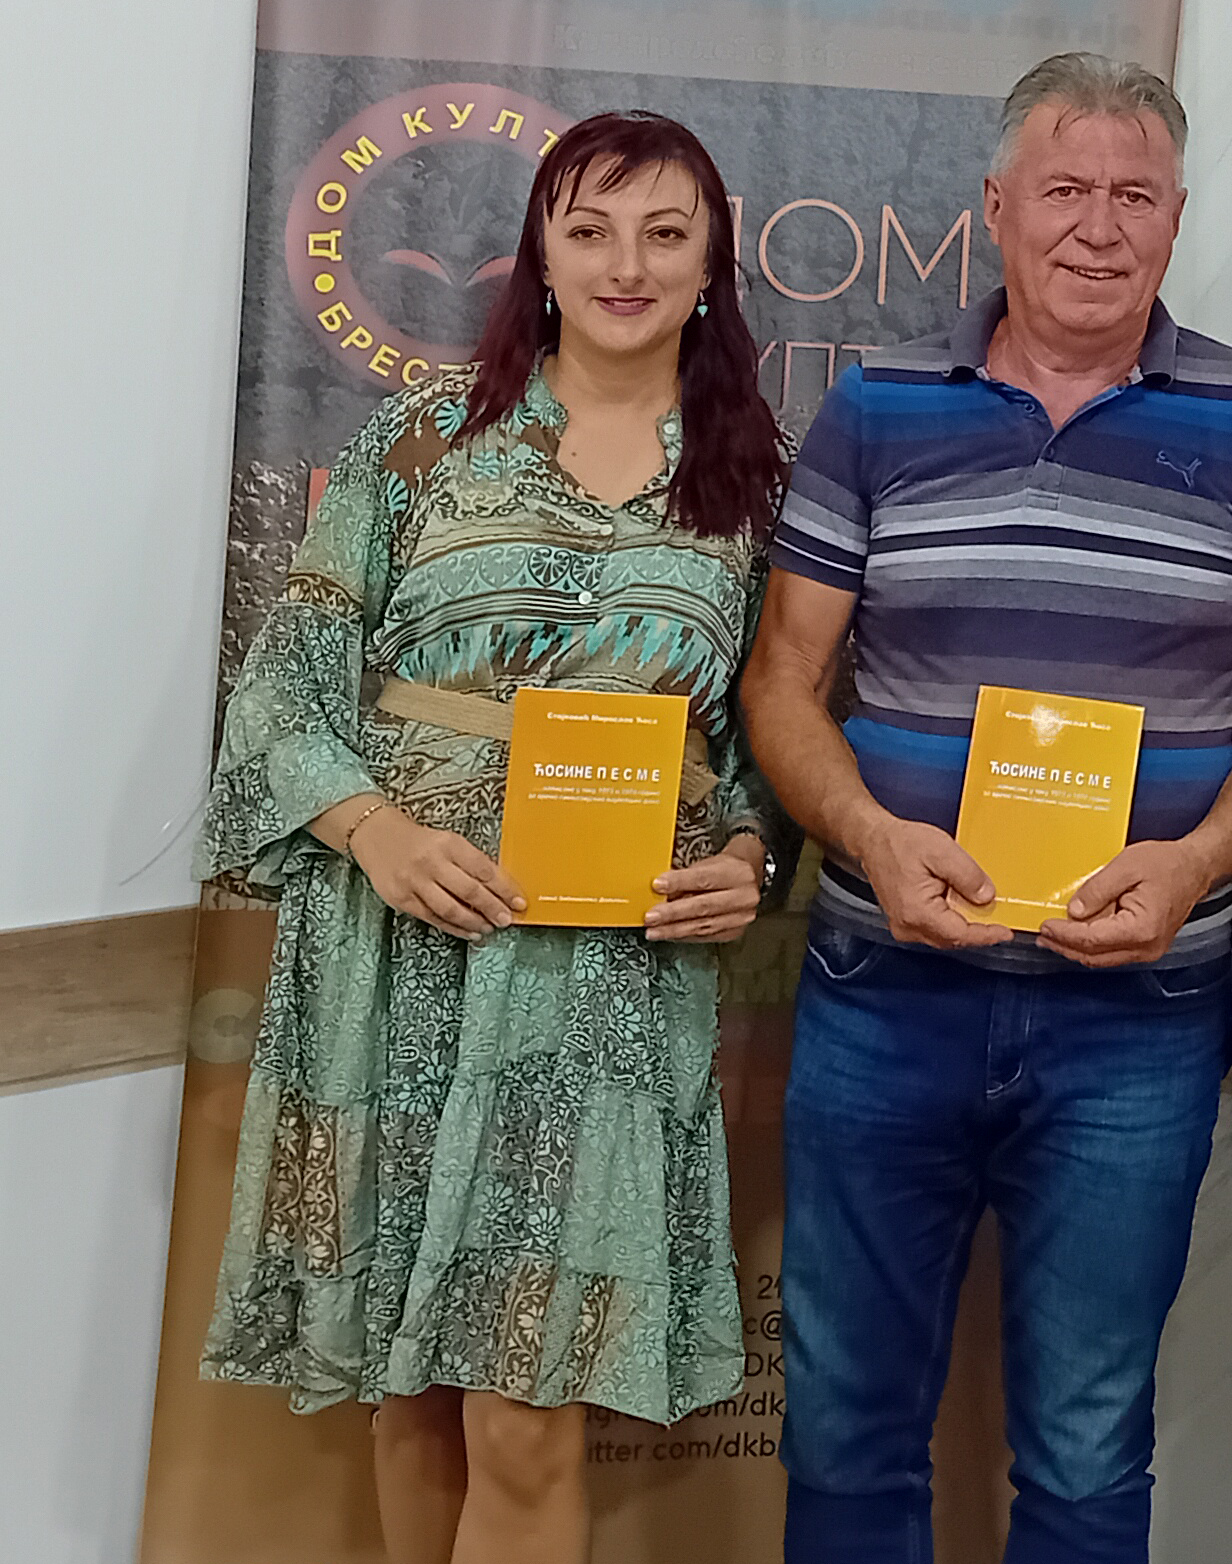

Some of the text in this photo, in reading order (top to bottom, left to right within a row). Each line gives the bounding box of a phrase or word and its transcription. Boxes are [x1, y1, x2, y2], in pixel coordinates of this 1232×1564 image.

[308, 136, 382, 262] ДОМ
[728, 196, 972, 309] ОМ
[317, 301, 466, 386] БРЕС
[533, 762, 593, 781] ЋОСИНЕ
[989, 760, 1046, 782] ЋОСИНЕ
